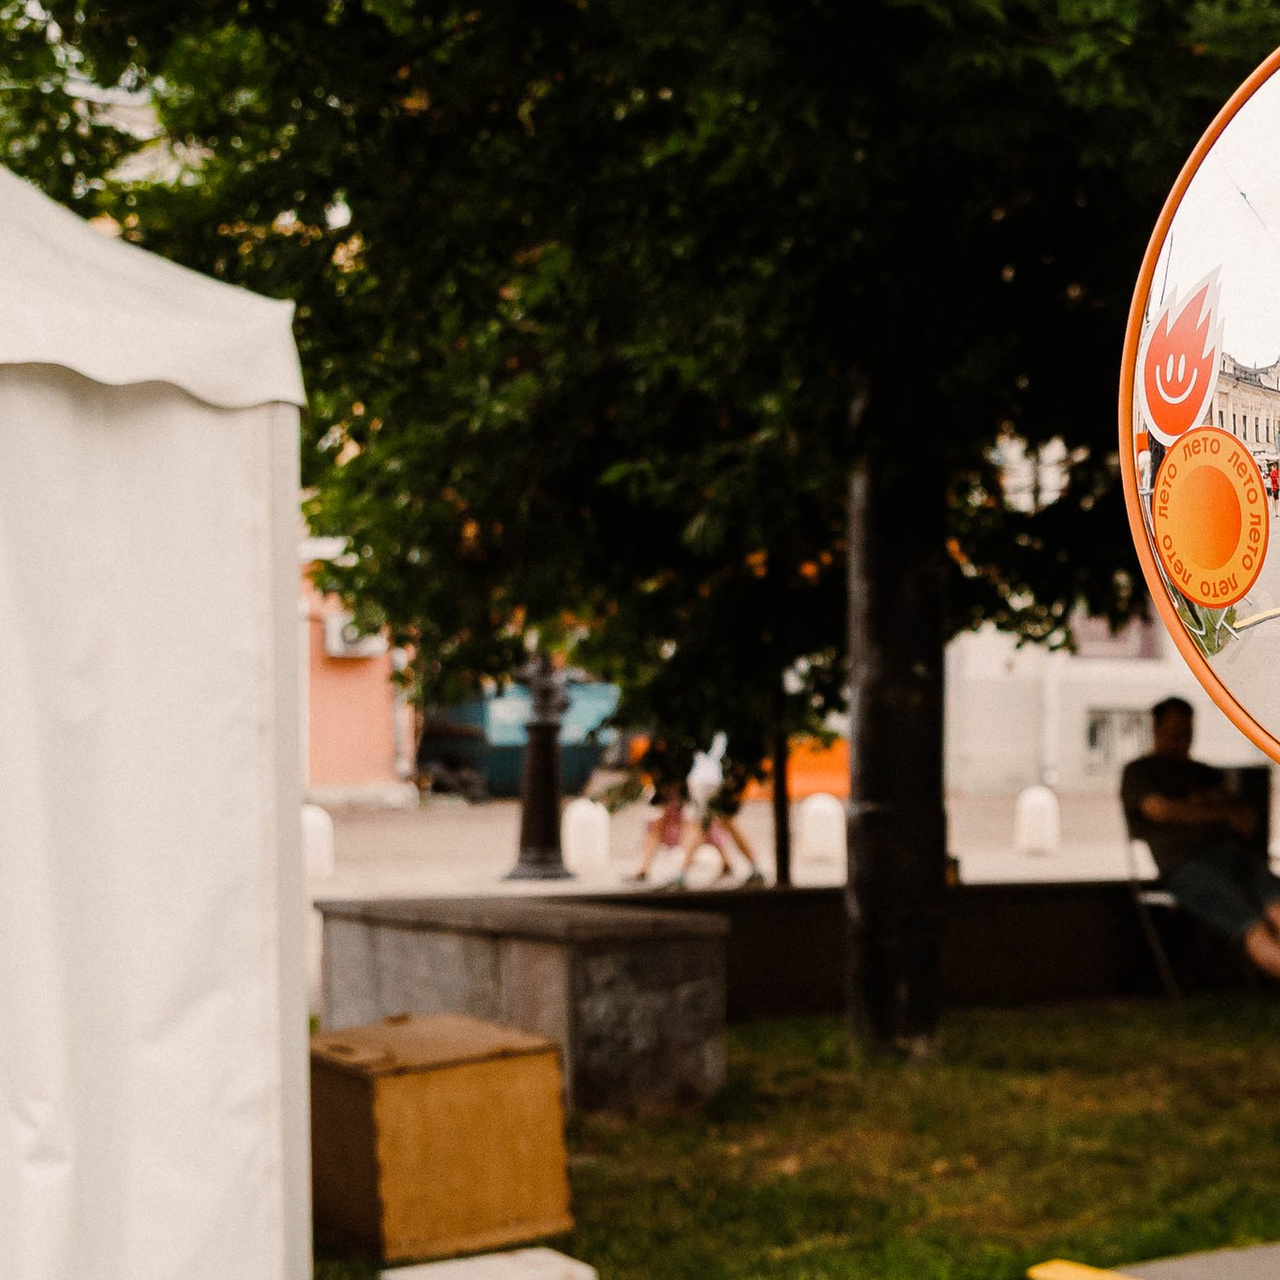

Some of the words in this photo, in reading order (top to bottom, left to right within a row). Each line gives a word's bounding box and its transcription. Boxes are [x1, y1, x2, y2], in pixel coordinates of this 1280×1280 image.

[1183, 436, 1221, 462] лето
[1159, 463, 1177, 520] лето
[1229, 451, 1258, 505] лето
[1162, 534, 1193, 586] лето
[1242, 513, 1261, 571] лето
[1200, 572, 1239, 598] лето
